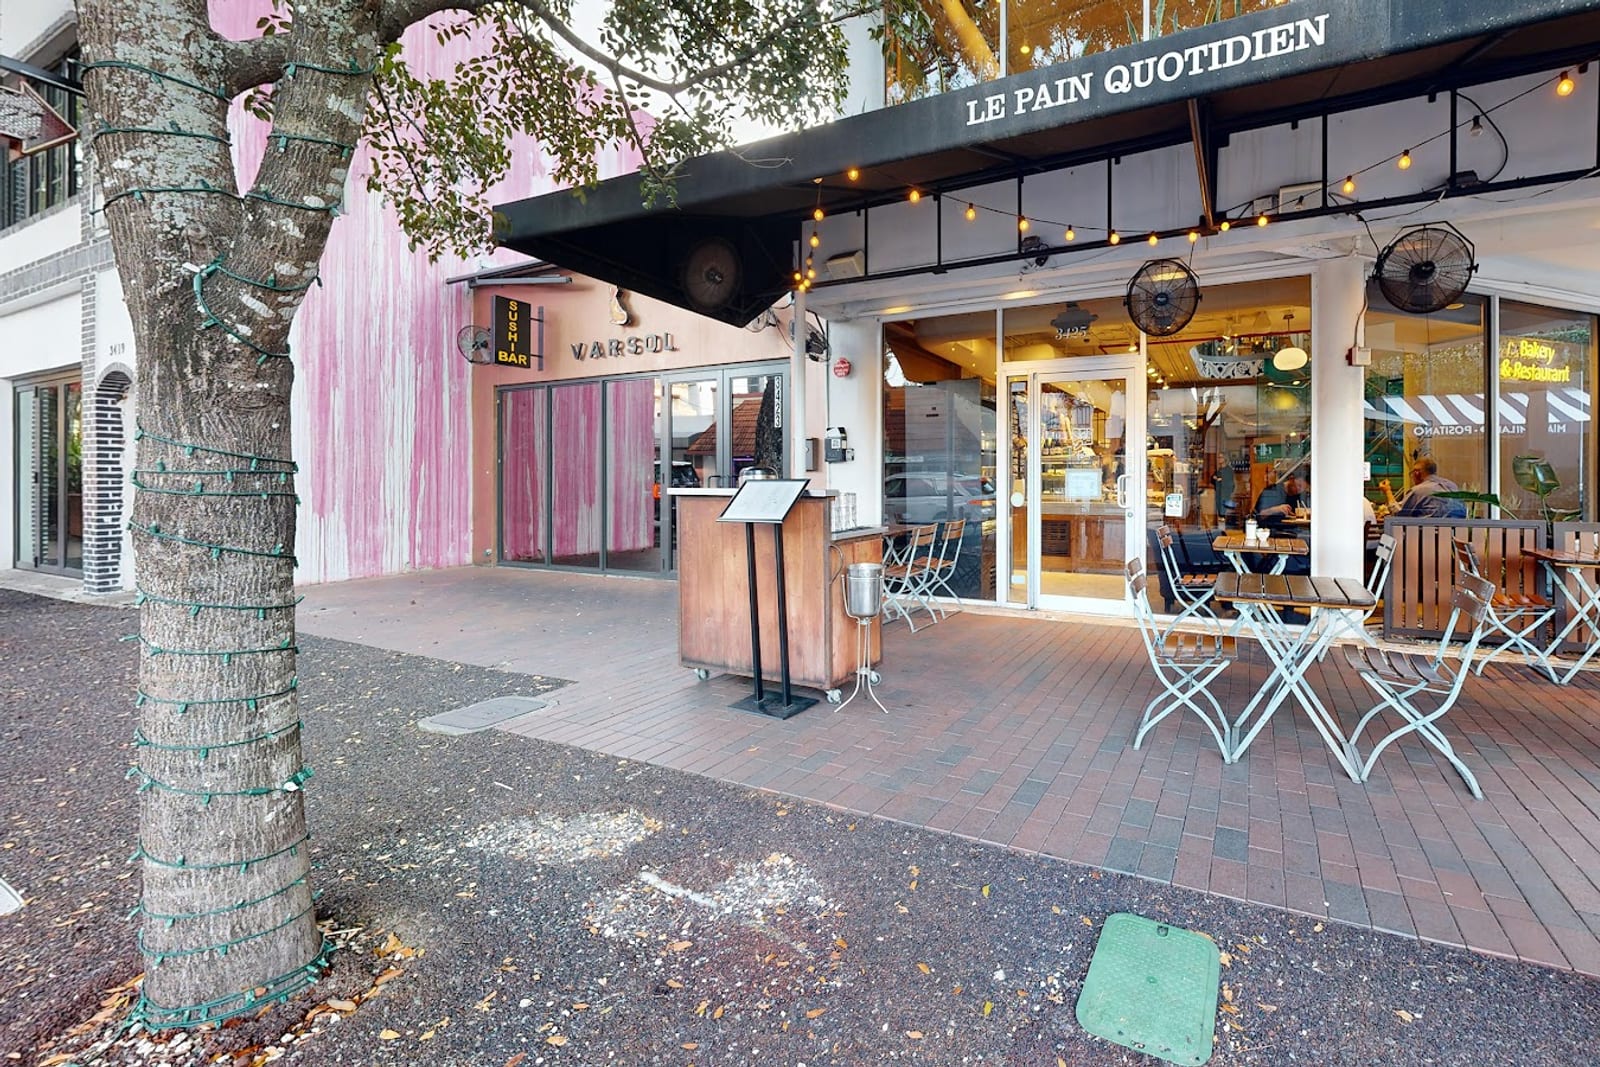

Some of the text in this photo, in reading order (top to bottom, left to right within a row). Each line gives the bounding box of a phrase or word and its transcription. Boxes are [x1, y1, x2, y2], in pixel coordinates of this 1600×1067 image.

[966, 13, 1330, 126] LE PAIN QUOTIDIEN
[508, 300, 518, 352] SUSHI
[1055, 325, 1088, 340] 3425
[498, 350, 528, 365] BAR
[570, 332, 678, 361] VARSOL
[1520, 340, 1555, 365] Bakery
[1500, 358, 1570, 382] & Restaurant
[774, 374, 782, 428] 3423
